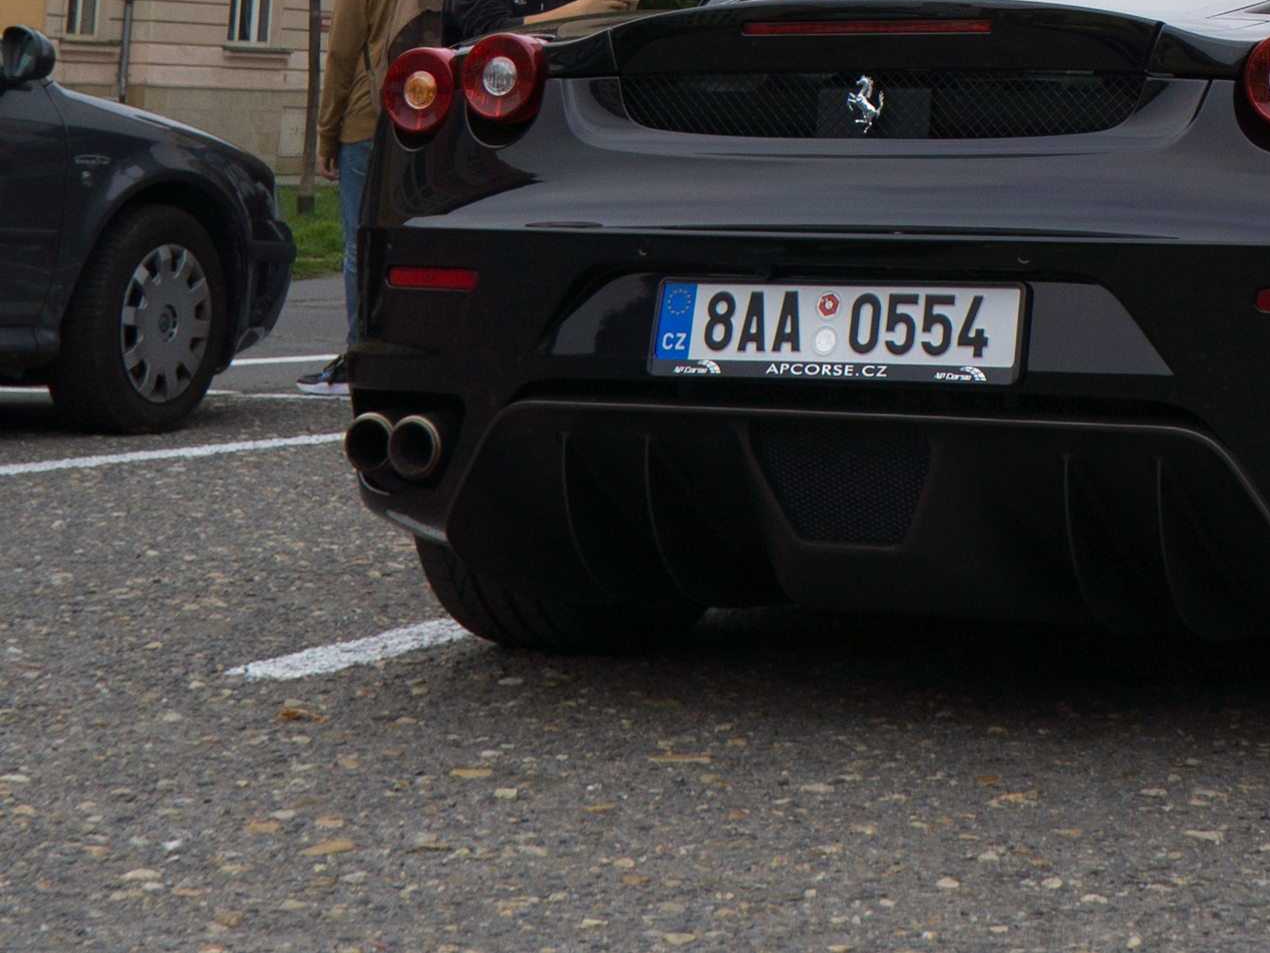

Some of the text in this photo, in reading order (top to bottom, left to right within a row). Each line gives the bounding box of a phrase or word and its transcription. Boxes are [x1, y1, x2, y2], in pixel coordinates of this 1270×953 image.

[704, 290, 989, 358] 8AA 0554
[662, 332, 687, 350] CZ
[765, 362, 888, 378] APCORSE.CZ
